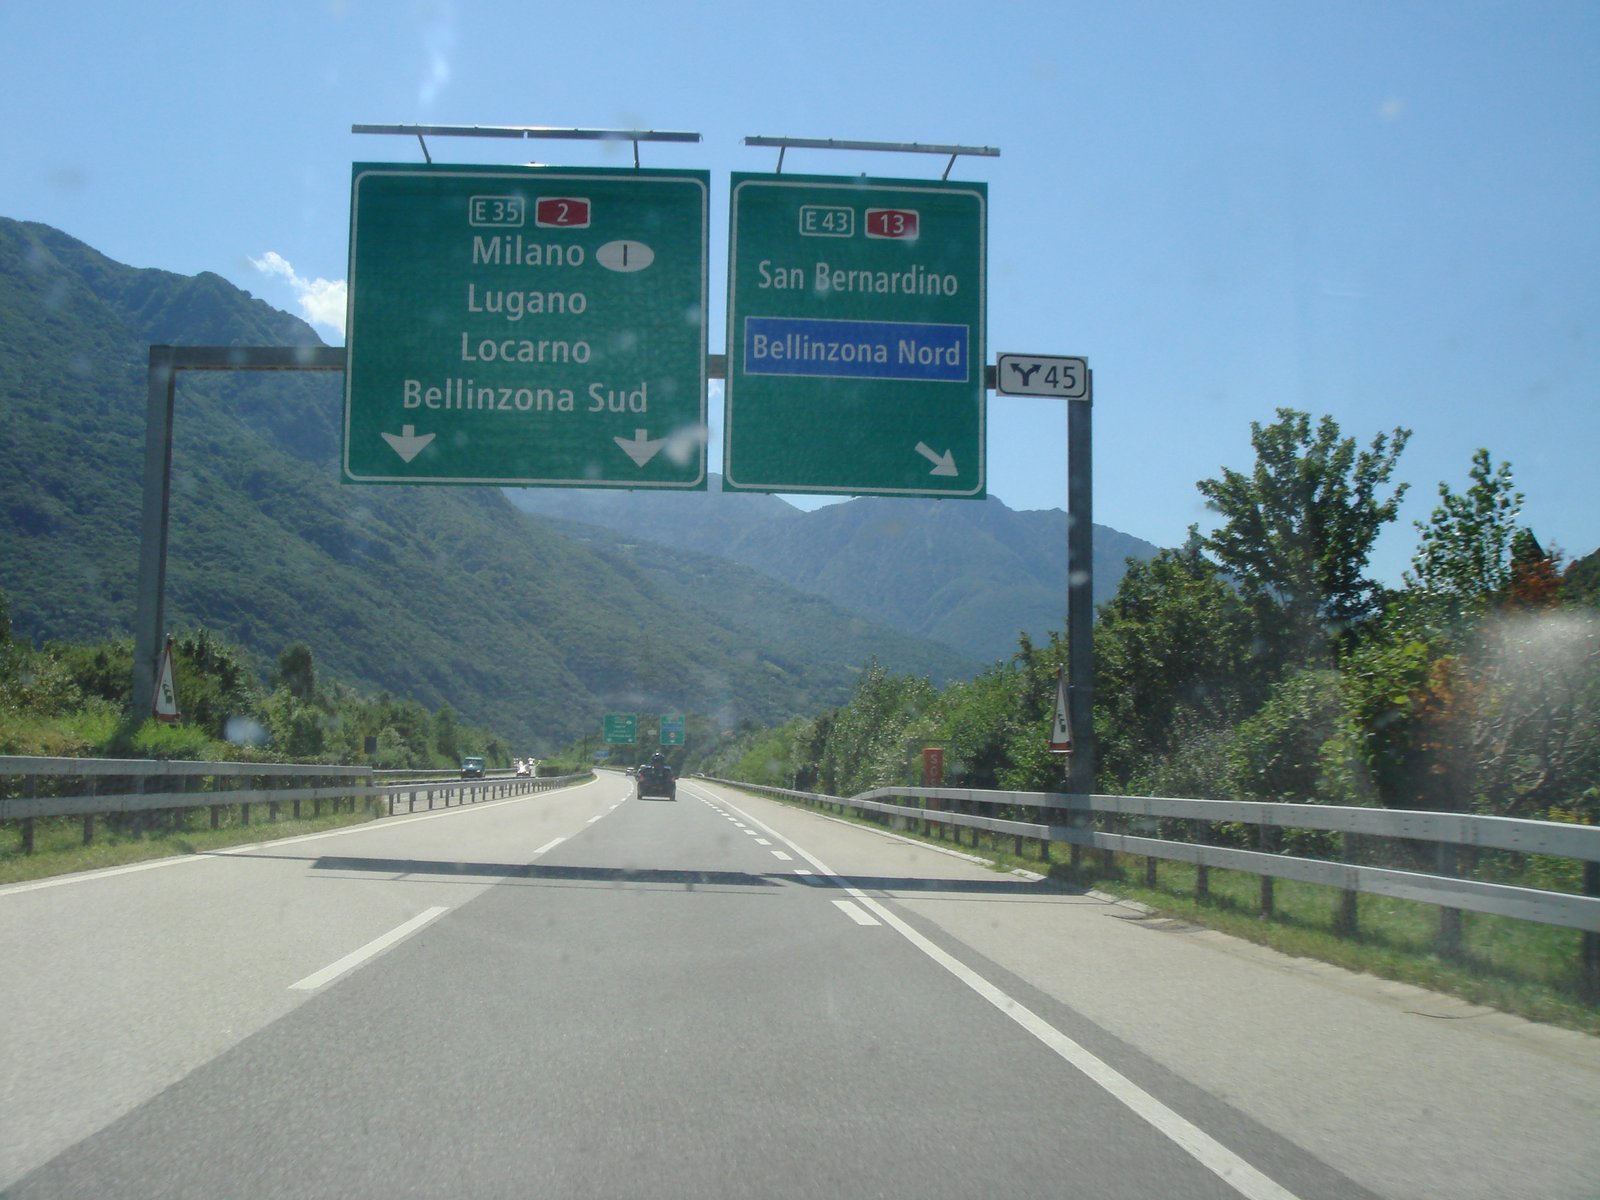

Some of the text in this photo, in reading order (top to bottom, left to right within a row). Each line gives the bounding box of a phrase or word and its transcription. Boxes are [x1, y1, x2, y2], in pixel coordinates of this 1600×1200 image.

[475, 202, 518, 221] E 35
[557, 203, 569, 222] 2
[806, 212, 848, 231] E 43
[880, 214, 904, 234] 13
[472, 235, 586, 267] Milano
[758, 260, 958, 296] San Bernardino
[468, 284, 587, 321] Lugano
[462, 332, 592, 364] Locarno
[753, 334, 960, 367] Bellinzona Nord
[1045, 366, 1077, 390] 45
[404, 378, 647, 414] Bellinzona Sud
